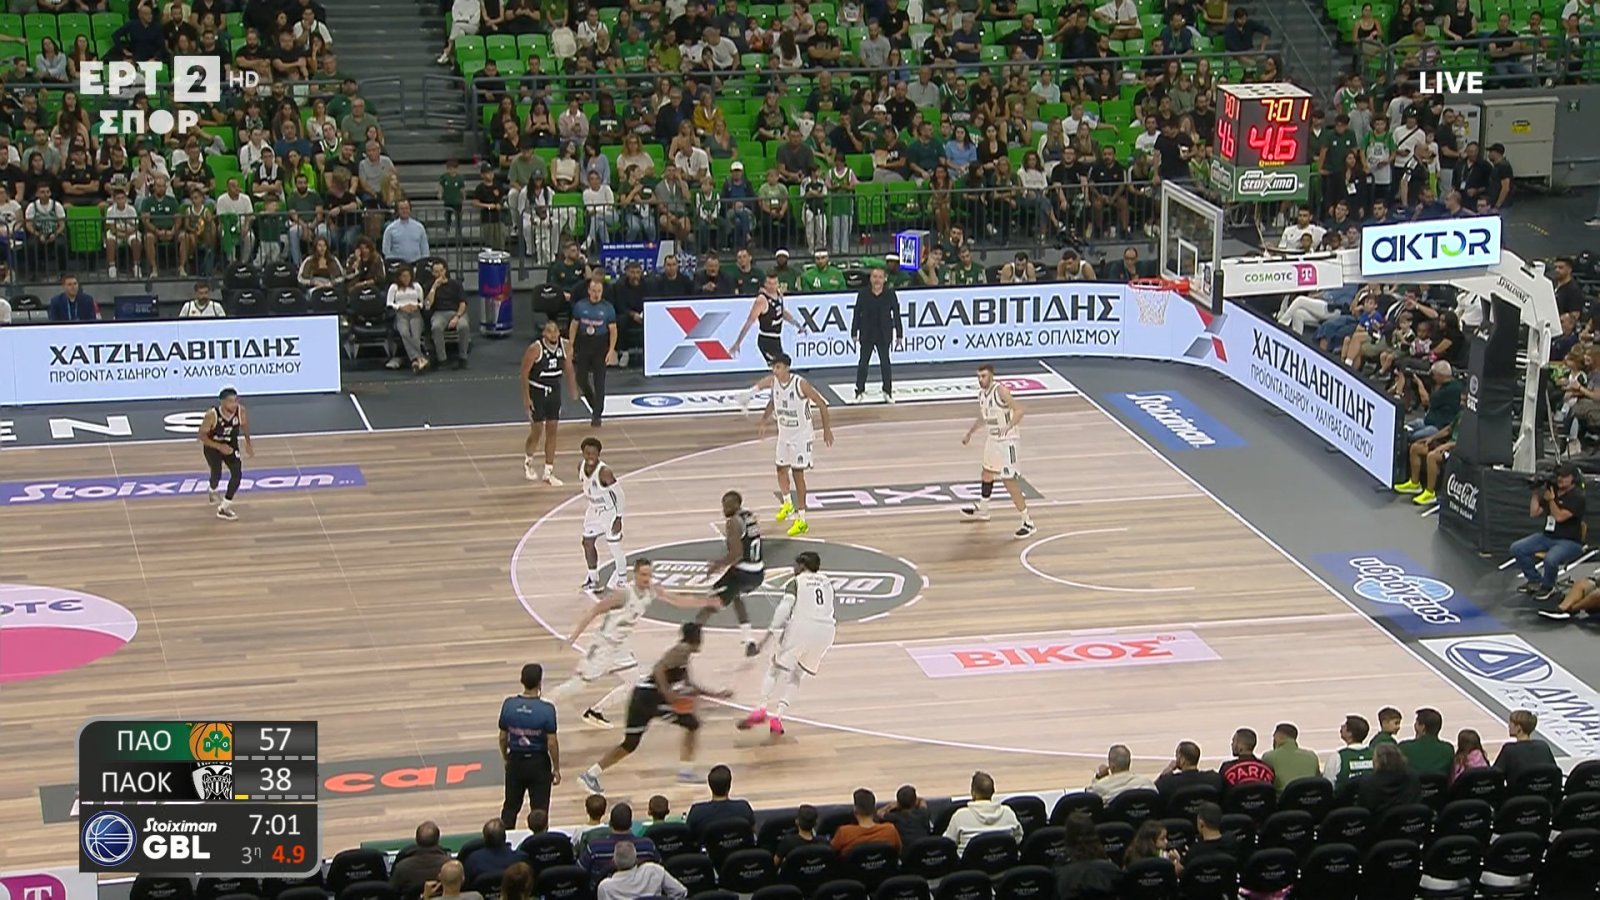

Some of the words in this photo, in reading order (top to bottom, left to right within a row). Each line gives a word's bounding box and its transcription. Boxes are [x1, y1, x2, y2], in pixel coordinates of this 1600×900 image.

[1261, 98, 1309, 122] 7:01
[1249, 124, 1299, 161] 4.6
[49, 336, 301, 367] ΧΑΤΖΗΔΑΒΙΤΙΔΗΣ
[795, 337, 858, 359] ΠΡΟΪΟΝ
[965, 330, 1033, 350] ΧΑΛΥΒΑΣ
[1038, 328, 1121, 347] ΟΠΛΙΣΜΟΥ
[49, 367, 114, 384] ΠΡΟΪΟΝΤΑ
[117, 366, 169, 381] ΣΙΔΗΡΟΥ
[183, 363, 236, 378] ΧΑΛΥΒΑΣ
[239, 360, 302, 375] ΟΠΛΙΣΜΟΥ
[1251, 328, 1376, 436] ΧΑΤΖΗΔΑΒΙΤΙΔΗΣ
[815, 587, 825, 606] 8
[951, 640, 1174, 670] ΒΙΚΟΣ
